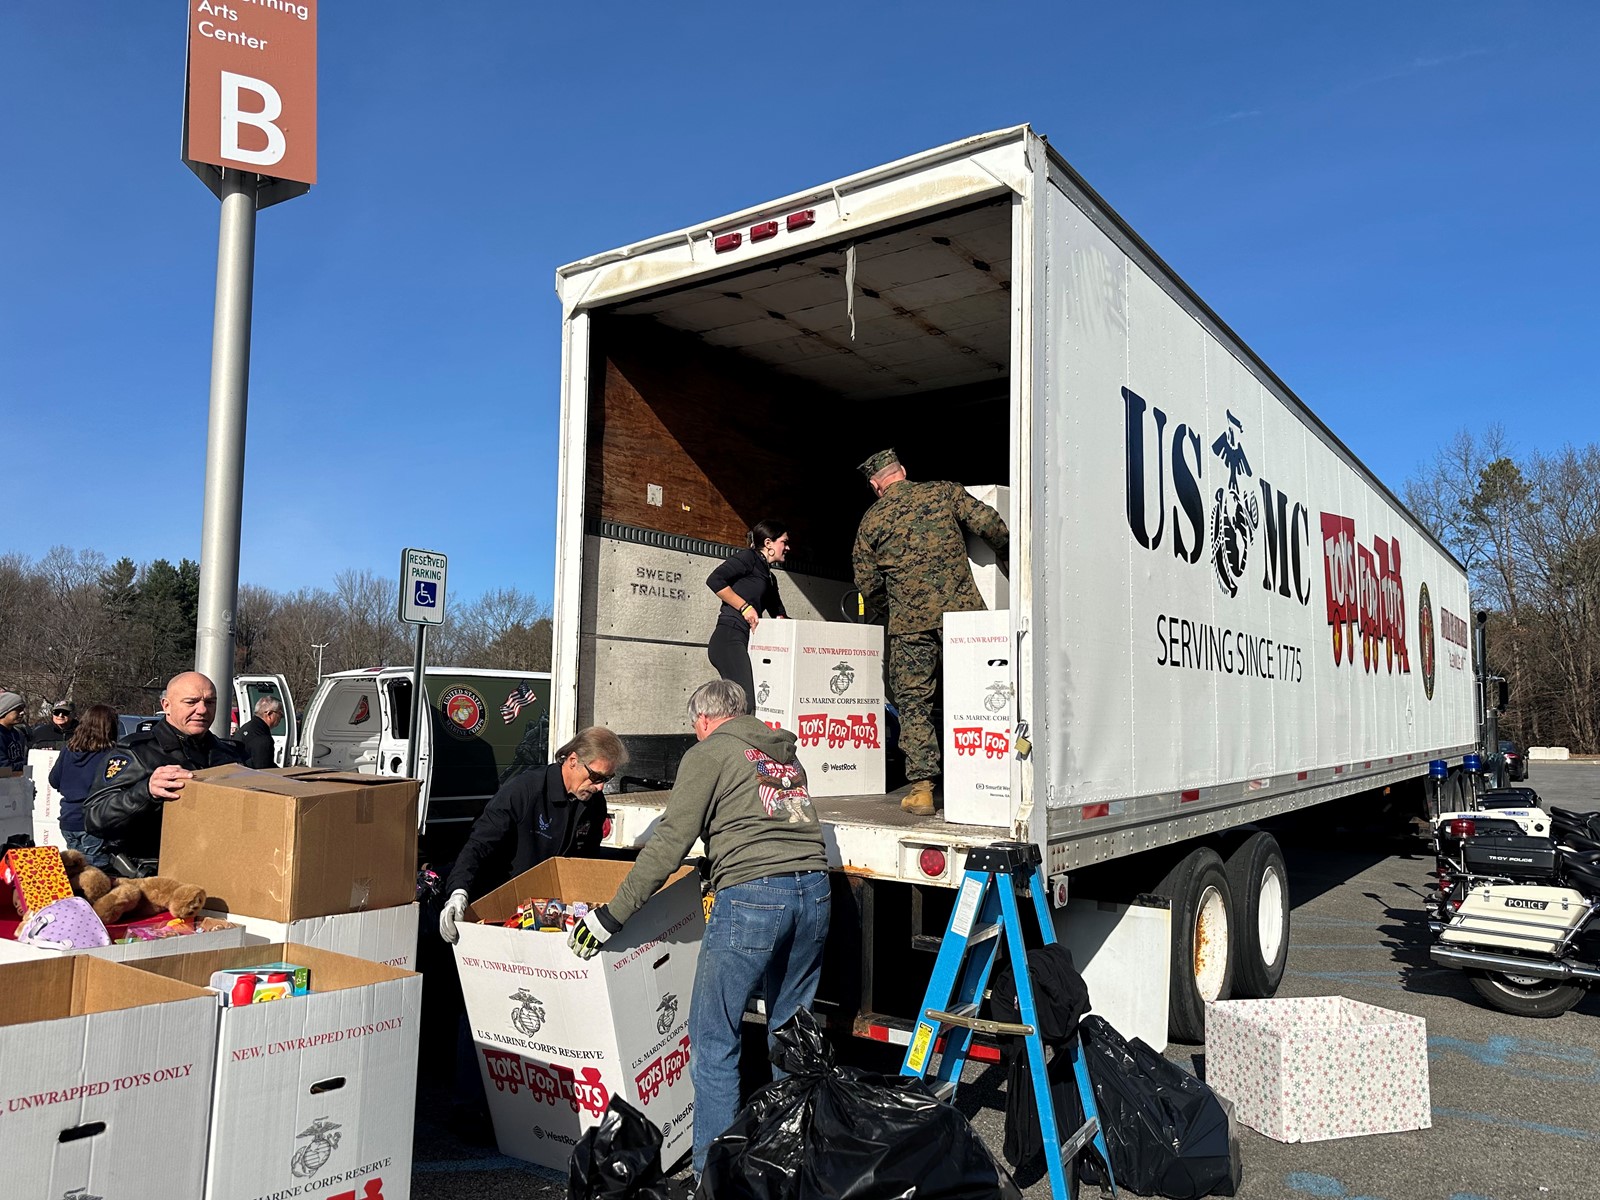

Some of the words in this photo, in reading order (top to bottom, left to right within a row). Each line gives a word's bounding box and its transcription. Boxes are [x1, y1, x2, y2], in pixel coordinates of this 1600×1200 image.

[198, 0, 238, 21] Arts
[198, 21, 267, 50] Center
[220, 71, 286, 166] B
[409, 554, 445, 568] RESERVED
[412, 567, 441, 580] PARKING
[636, 566, 682, 583] SWEEP
[630, 583, 686, 600] TRAILER
[1325, 530, 1355, 606] TOYS
[1359, 556, 1378, 625] FOR
[1381, 575, 1403, 640] TOTS
[967, 636, 1008, 644] UNWRAPPED
[1156, 614, 1233, 674] SERVING
[1237, 632, 1275, 680] SINCE
[1277, 643, 1302, 683] 1775
[803, 647, 817, 655] NEW,
[818, 647, 852, 656] UNWRAPPED
[443, 689, 463, 705] UNITED
[464, 690, 484, 710] STATES
[468, 718, 484, 735] CORPS
[800, 719, 824, 735] TOYS
[829, 722, 847, 738] FOR
[853, 725, 874, 740] TOTS
[955, 731, 981, 746] TOYS
[986, 735, 1006, 750] FOR
[830, 763, 857, 771] WestRock
[1508, 899, 1544, 909] POLICE
[613, 955, 631, 971] NEW,
[631, 931, 668, 960] UNWRAPPED
[667, 921, 682, 935] TOYS
[682, 910, 697, 926] ONLY
[390, 956, 408, 967] ONLY
[462, 957, 482, 968] NEW,
[482, 960, 534, 976] UNWRAPPED
[534, 968, 559, 979] TOYS
[559, 970, 589, 980] ONLY
[231, 1047, 265, 1062] NEW,
[267, 1030, 344, 1055] UNWRAPPED
[345, 1025, 374, 1039] TOYS
[375, 1017, 404, 1033] ONLY
[477, 1030, 492, 1040] U.S.
[493, 1033, 527, 1048] MARINE
[528, 1041, 558, 1055] CORPS
[558, 1047, 604, 1060] RESERVE
[631, 1057, 643, 1069] U.S.
[643, 1038, 667, 1061] MARINE
[666, 1023, 684, 1042] CORPS
[488, 1057, 521, 1080] TOYS
[528, 1068, 554, 1093] FOR
[562, 1081, 603, 1108] TOTS
[639, 1065, 661, 1092] TOYS
[665, 1055, 682, 1074] FOR
[8, 1081, 110, 1112] UNWRAPPED
[113, 1073, 151, 1092] TOYS
[153, 1064, 193, 1083] ONLY
[304, 1176, 343, 1193] CORPS
[344, 1157, 392, 1180] RESERVE
